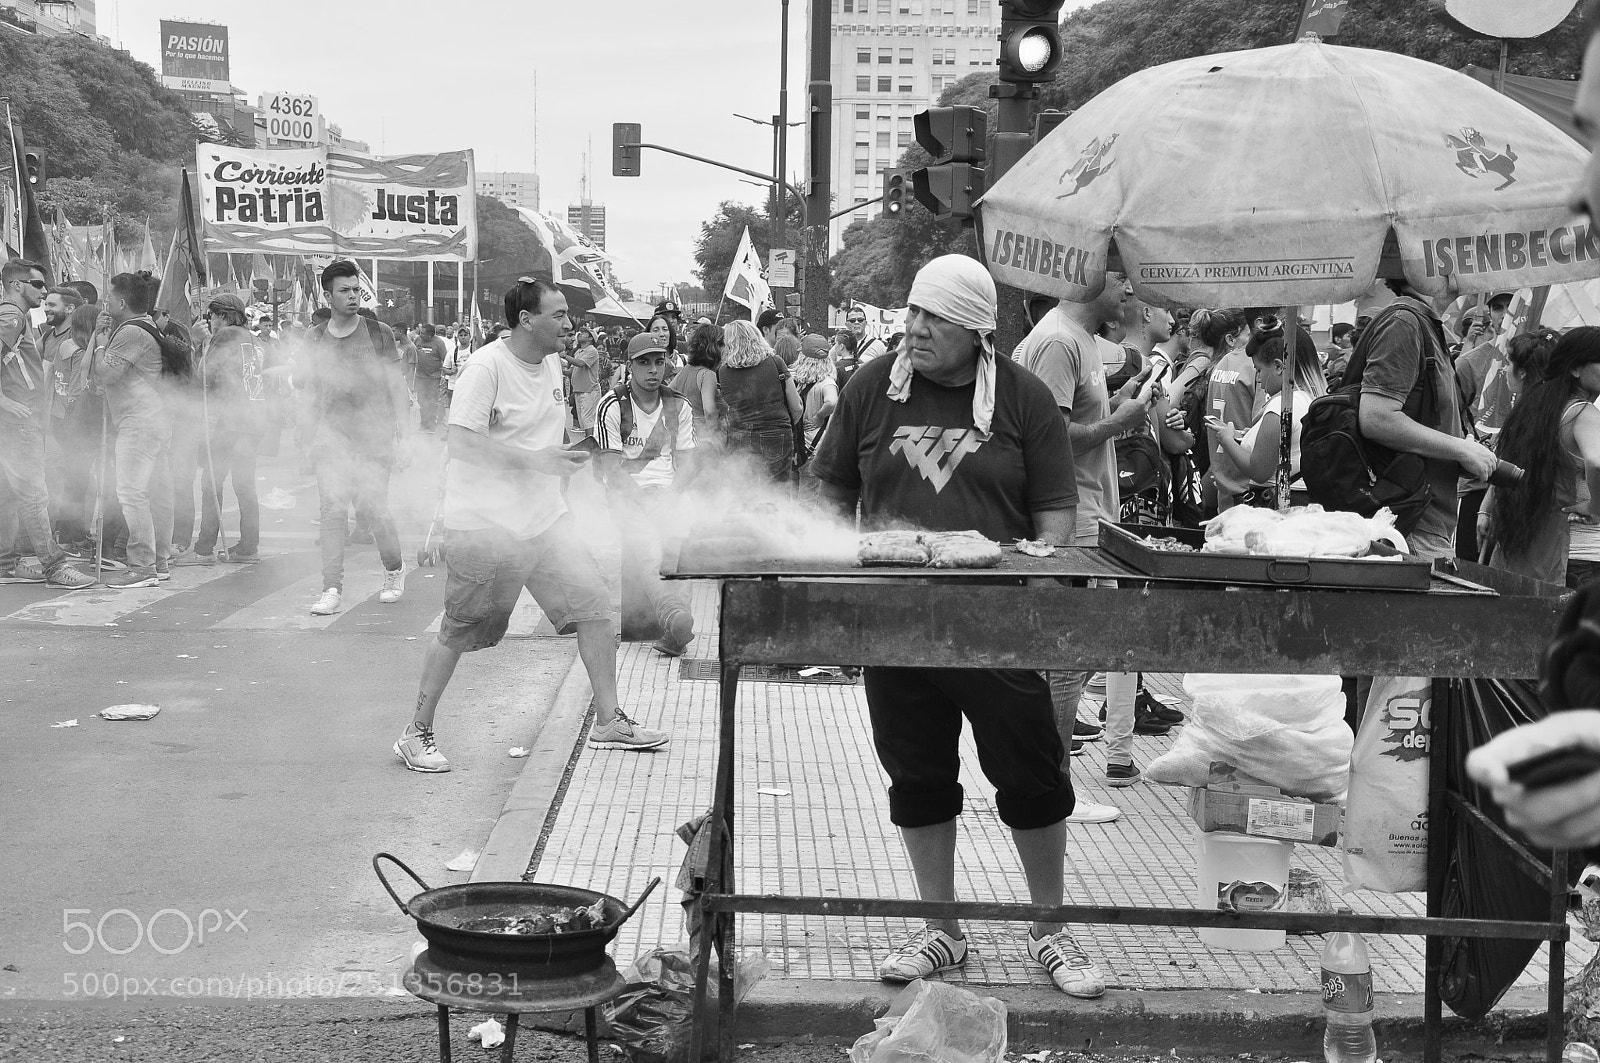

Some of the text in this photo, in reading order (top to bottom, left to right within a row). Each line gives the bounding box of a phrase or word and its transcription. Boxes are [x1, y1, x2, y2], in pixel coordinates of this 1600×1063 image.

[167, 35, 224, 53] PASIÓN
[198, 54, 225, 62] hacemos
[270, 96, 313, 117] 4362
[271, 118, 313, 139] 0000
[213, 160, 324, 185] Corriente
[215, 186, 458, 226] Patria Justa
[991, 229, 1089, 287] ISENBECK
[1422, 223, 1600, 279] ISENBECK
[1140, 262, 1354, 279] CERVEZA PREMIUM ARGENTINA
[1388, 833, 1420, 841] Buenos
